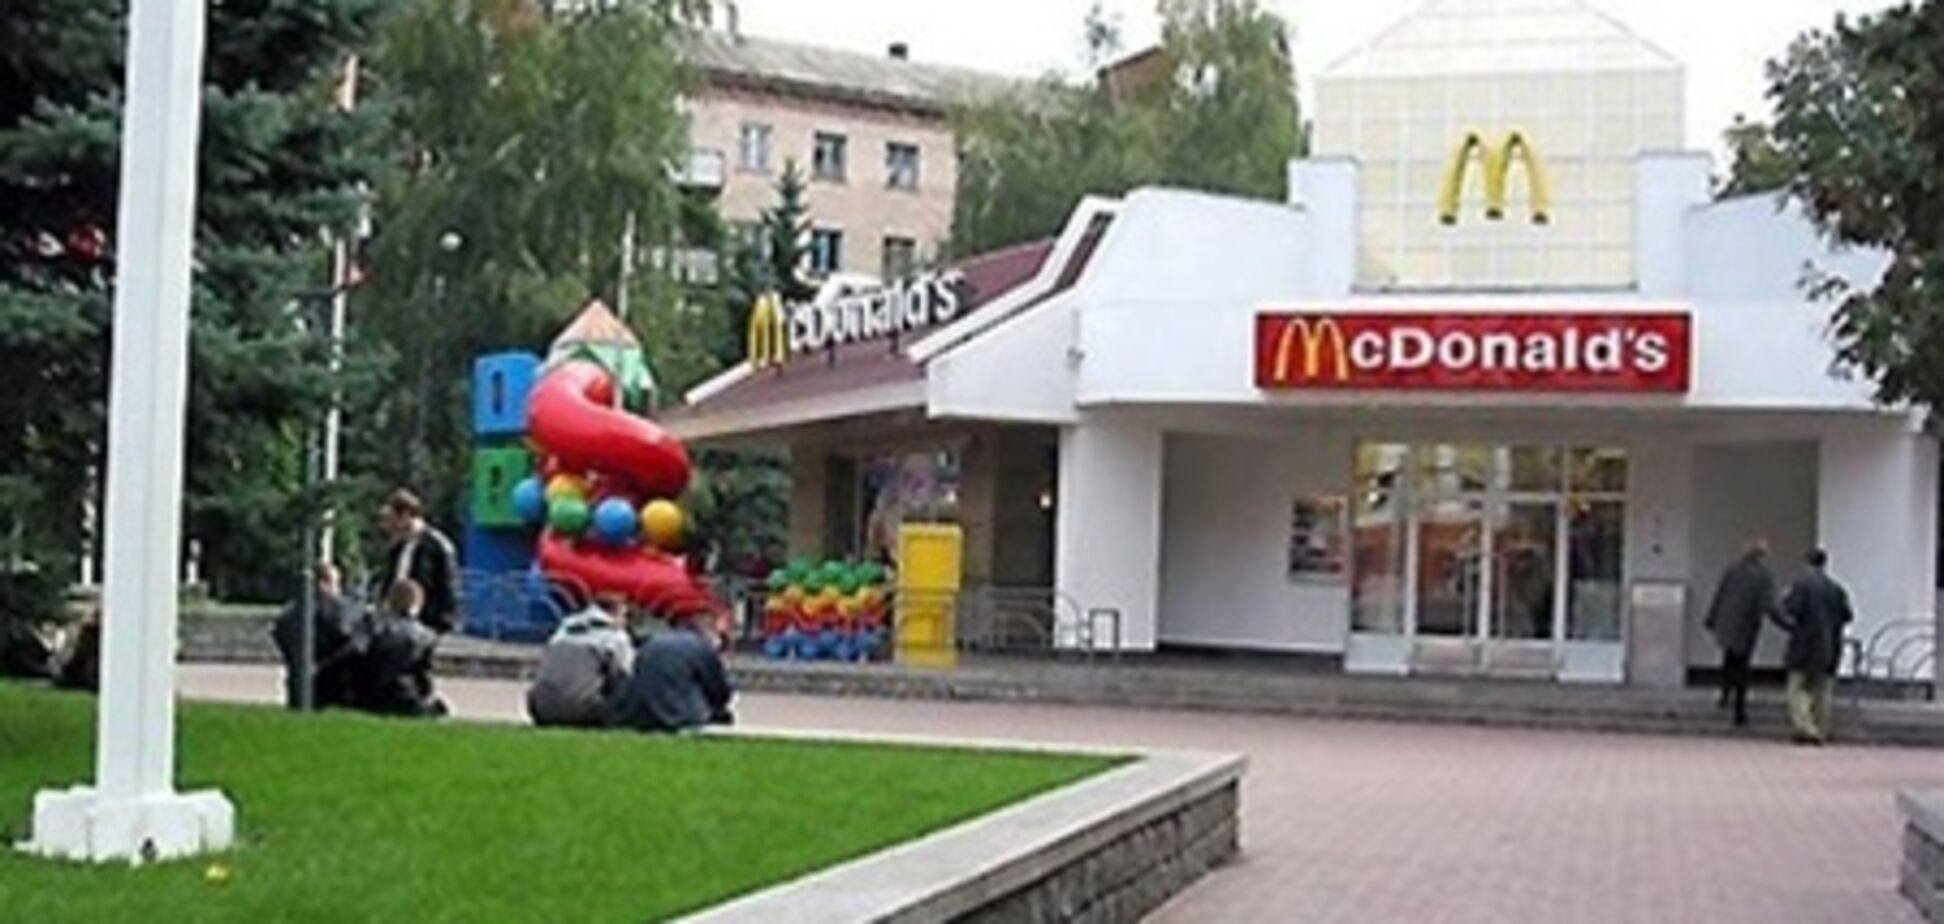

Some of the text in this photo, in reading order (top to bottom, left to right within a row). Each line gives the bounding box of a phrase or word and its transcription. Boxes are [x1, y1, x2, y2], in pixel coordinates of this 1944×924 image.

[1438, 131, 1549, 225] M
[749, 272, 963, 368] McDonald's
[1274, 318, 1669, 381] McDonald's
